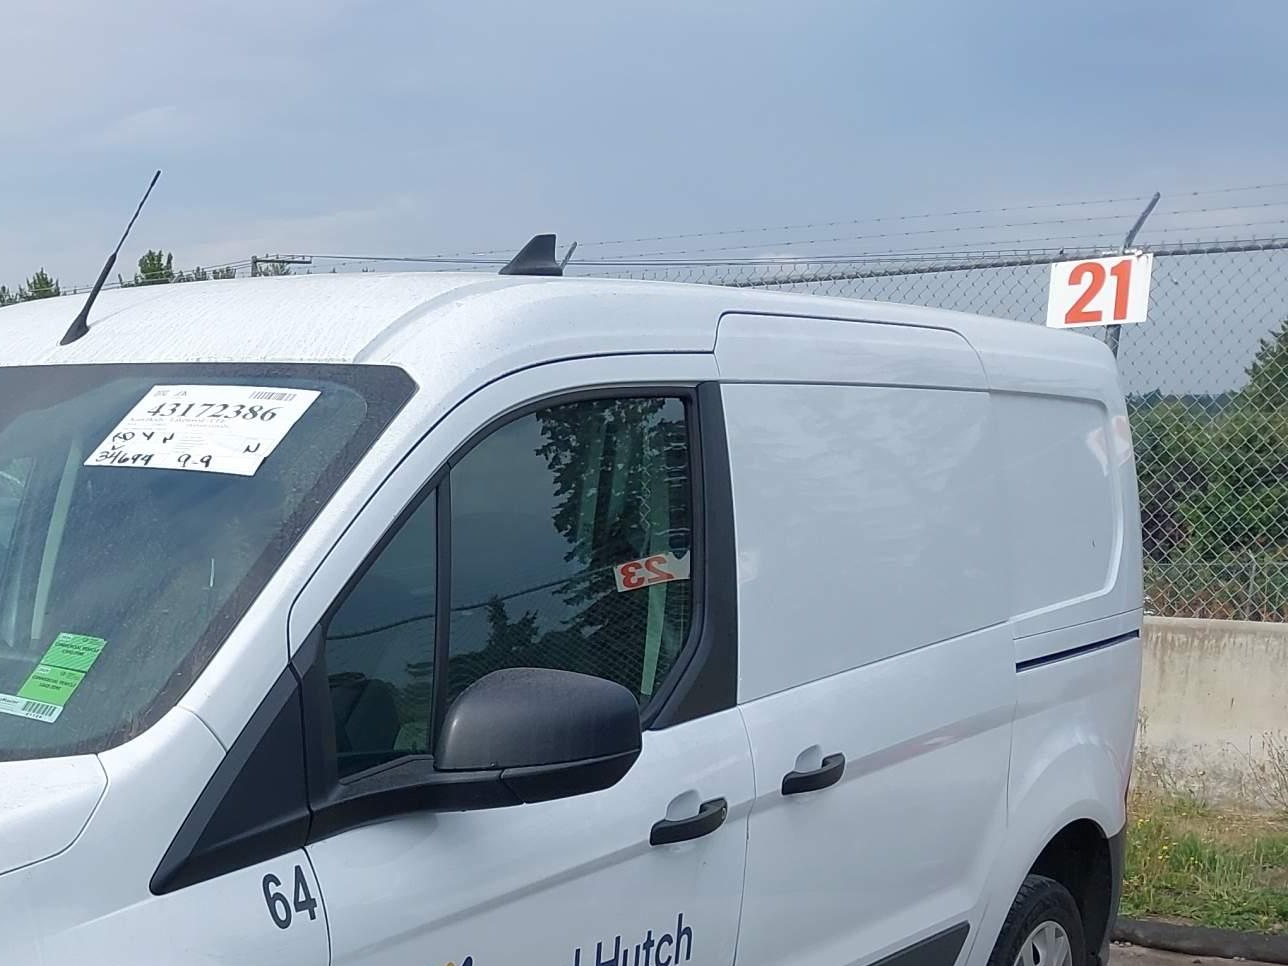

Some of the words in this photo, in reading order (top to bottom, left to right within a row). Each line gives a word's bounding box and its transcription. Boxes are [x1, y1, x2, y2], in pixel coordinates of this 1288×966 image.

[1064, 259, 1132, 325] 21
[147, 402, 283, 422] 43172386
[262, 864, 318, 929] 64
